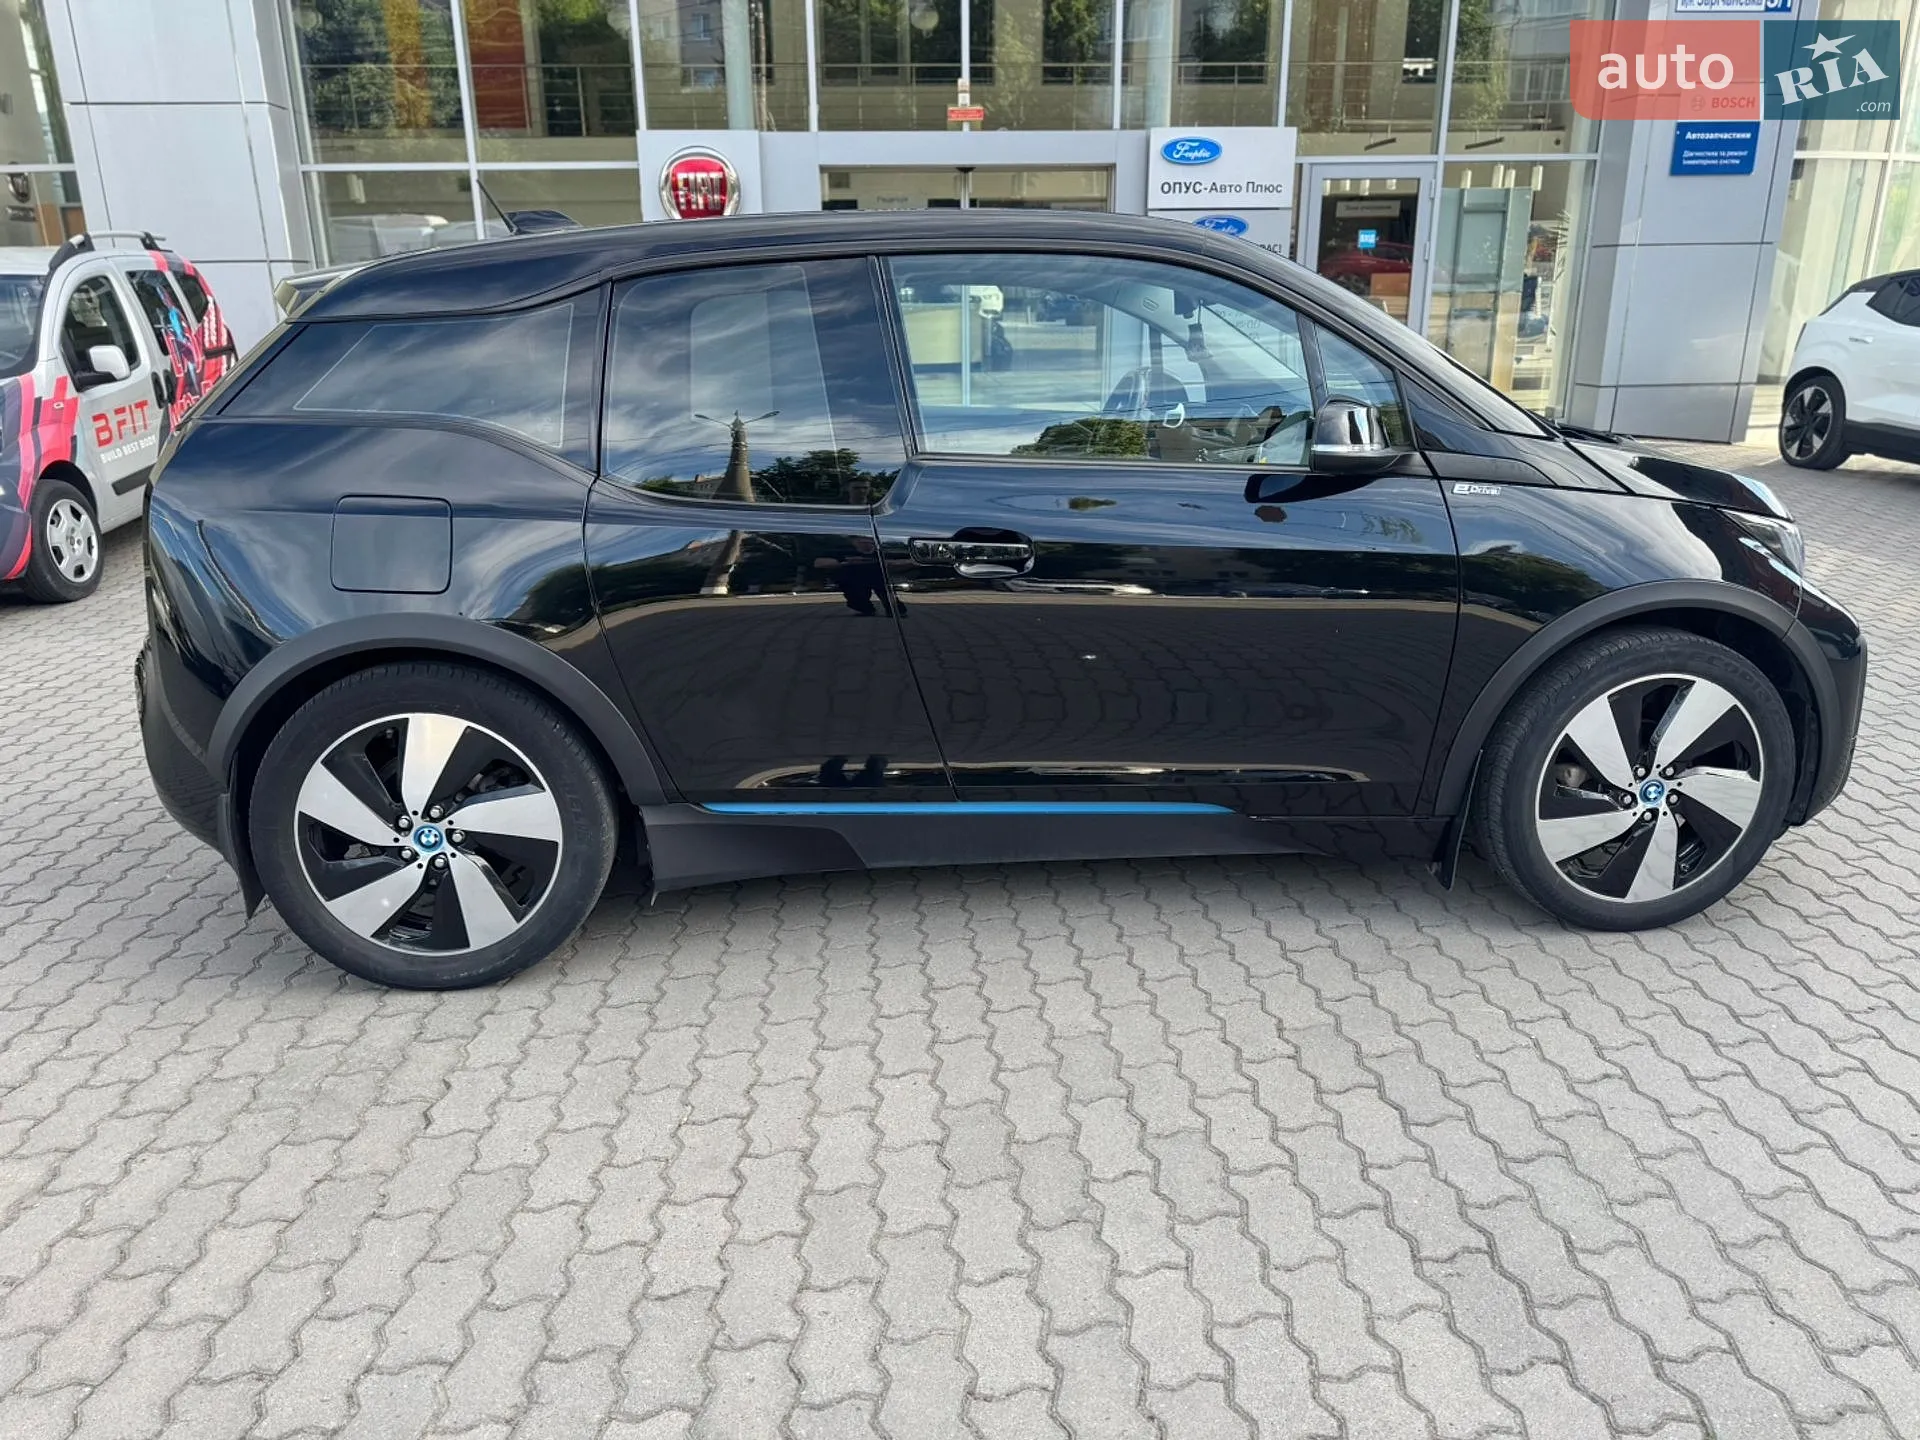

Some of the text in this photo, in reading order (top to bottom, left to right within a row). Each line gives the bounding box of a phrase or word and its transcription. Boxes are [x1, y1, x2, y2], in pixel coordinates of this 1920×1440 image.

[1711, 97, 1756, 109] BOSCH
[676, 171, 724, 210] FIAT
[1160, 181, 1283, 195] ОПУС-Авто Плюс
[100, 434, 156, 464] BUILD BEST BODY
